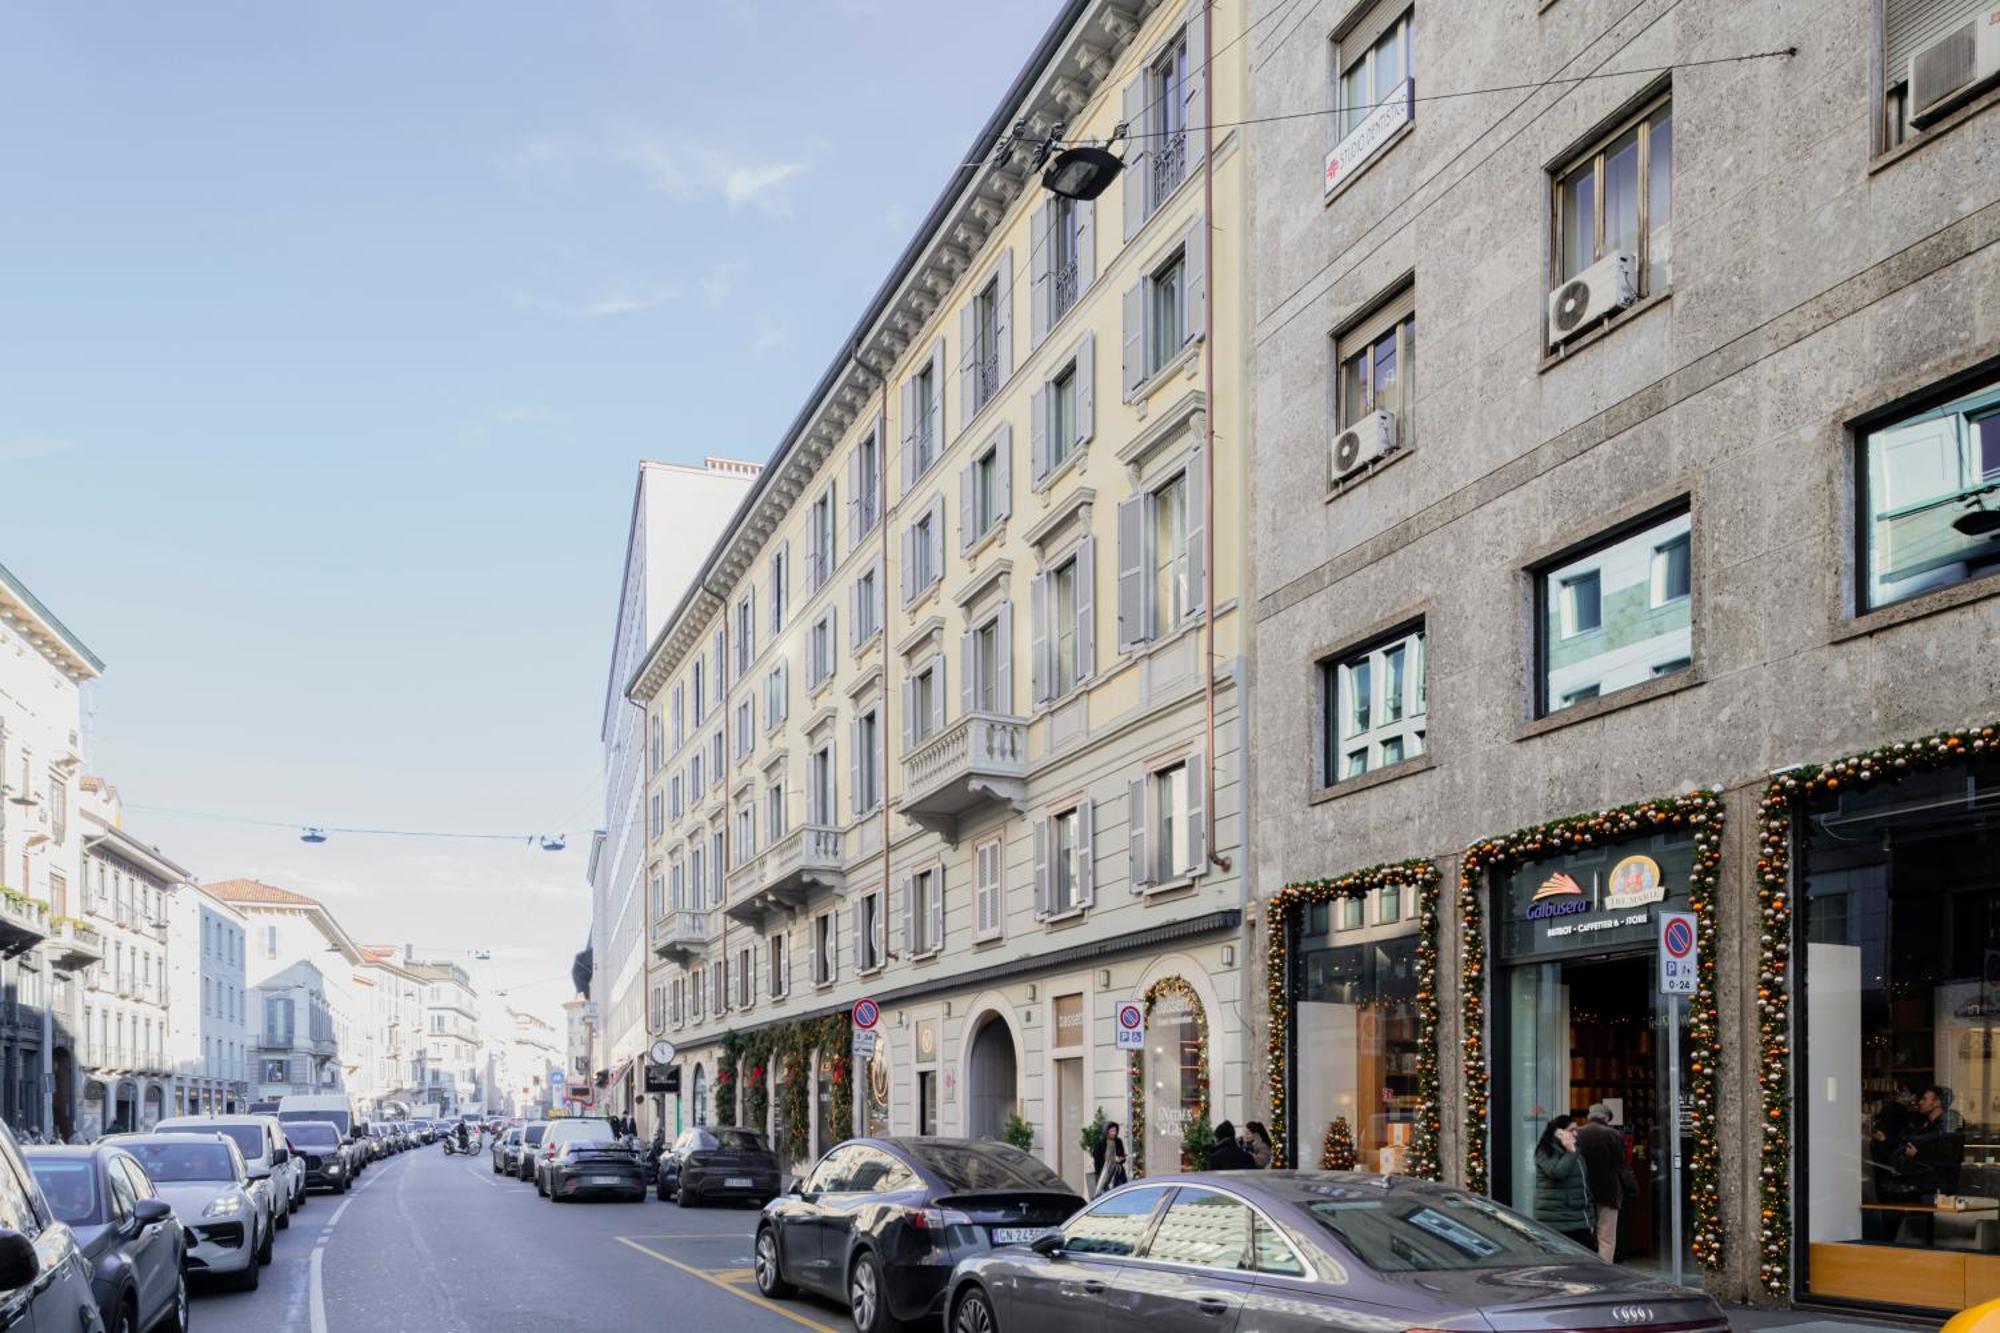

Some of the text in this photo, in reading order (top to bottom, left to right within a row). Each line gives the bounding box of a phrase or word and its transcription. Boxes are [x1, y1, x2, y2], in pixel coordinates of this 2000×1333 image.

[1340, 134, 1364, 169] STUDIO
[1526, 900, 1586, 919] Galbusera
[1625, 914, 1648, 926] STORE
